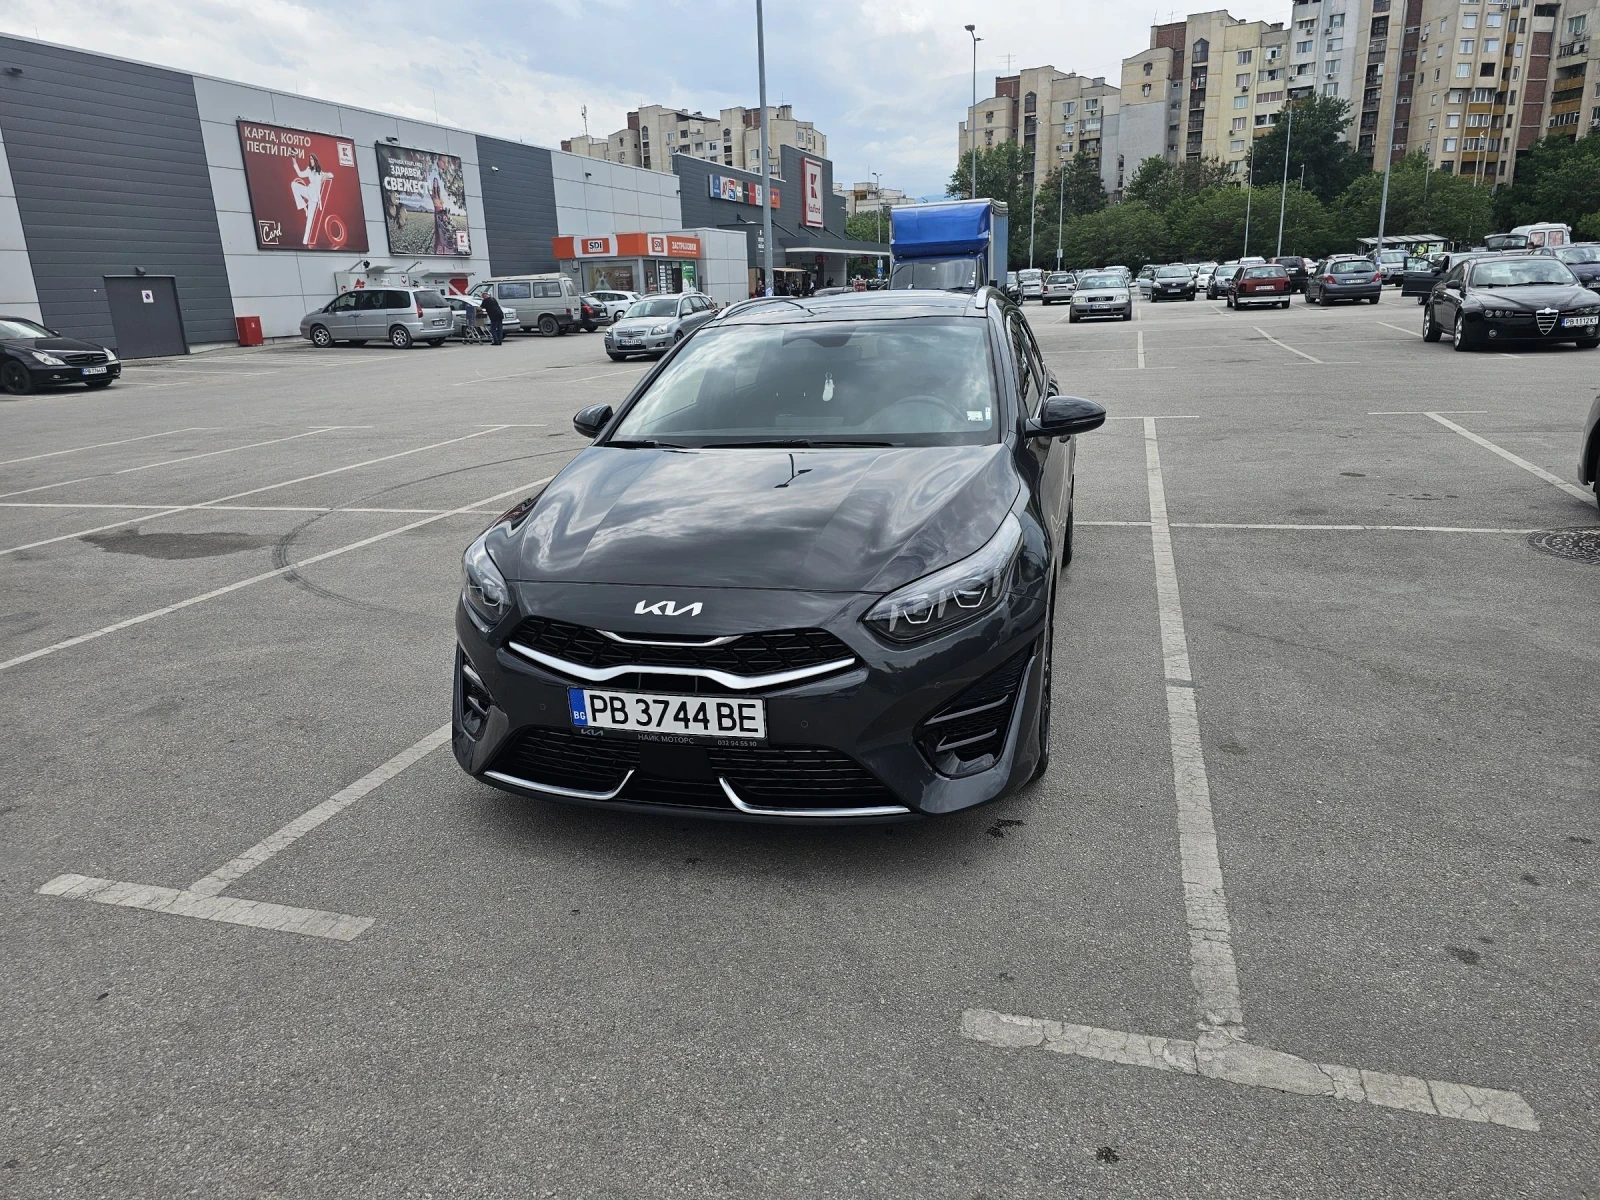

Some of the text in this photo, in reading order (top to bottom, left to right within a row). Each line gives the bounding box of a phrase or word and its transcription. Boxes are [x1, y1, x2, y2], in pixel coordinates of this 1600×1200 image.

[244, 126, 312, 147] КАРТА, КОЯТО
[246, 140, 278, 156] ПЕСТИ
[263, 222, 282, 241] Card
[589, 241, 603, 249] SDI
[634, 600, 703, 617] KIA
[573, 711, 586, 720] BG
[589, 694, 759, 733] PB 3744 BE
[580, 728, 604, 737] KIA
[638, 733, 695, 745] НАЙК МОТОРС
